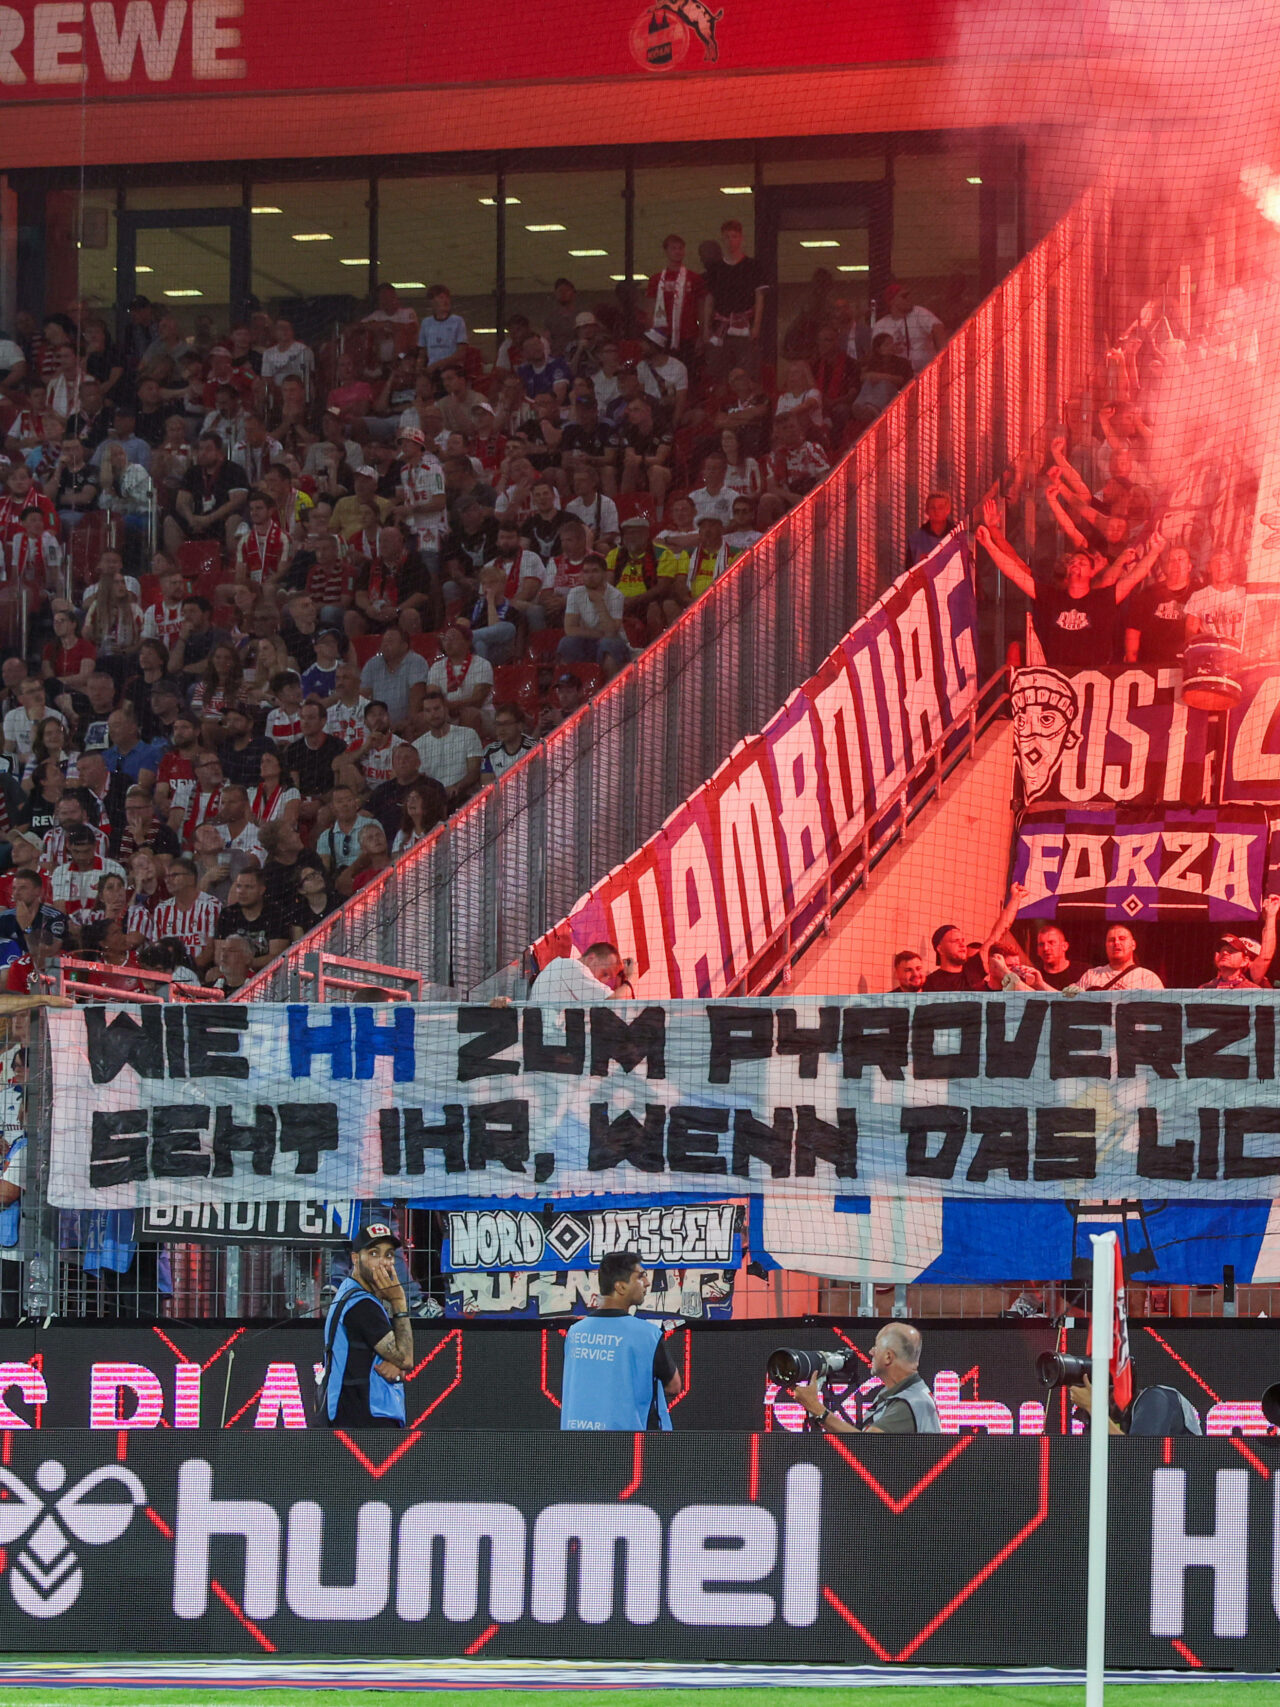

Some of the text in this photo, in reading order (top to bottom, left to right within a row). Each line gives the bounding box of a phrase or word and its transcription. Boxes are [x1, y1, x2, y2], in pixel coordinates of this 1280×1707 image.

[85, 1005, 249, 1084] WIE
[287, 1004, 415, 1082] HH
[457, 1006, 666, 1082] ZUM
[89, 1102, 339, 1188] SEHT
[379, 1100, 555, 1183] IHR,
[588, 1101, 858, 1179] WENN
[900, 1104, 1097, 1181] DAS
[449, 1210, 545, 1268] NORD
[589, 1204, 735, 1265] HESSEN
[172, 1459, 822, 1629] hummel
